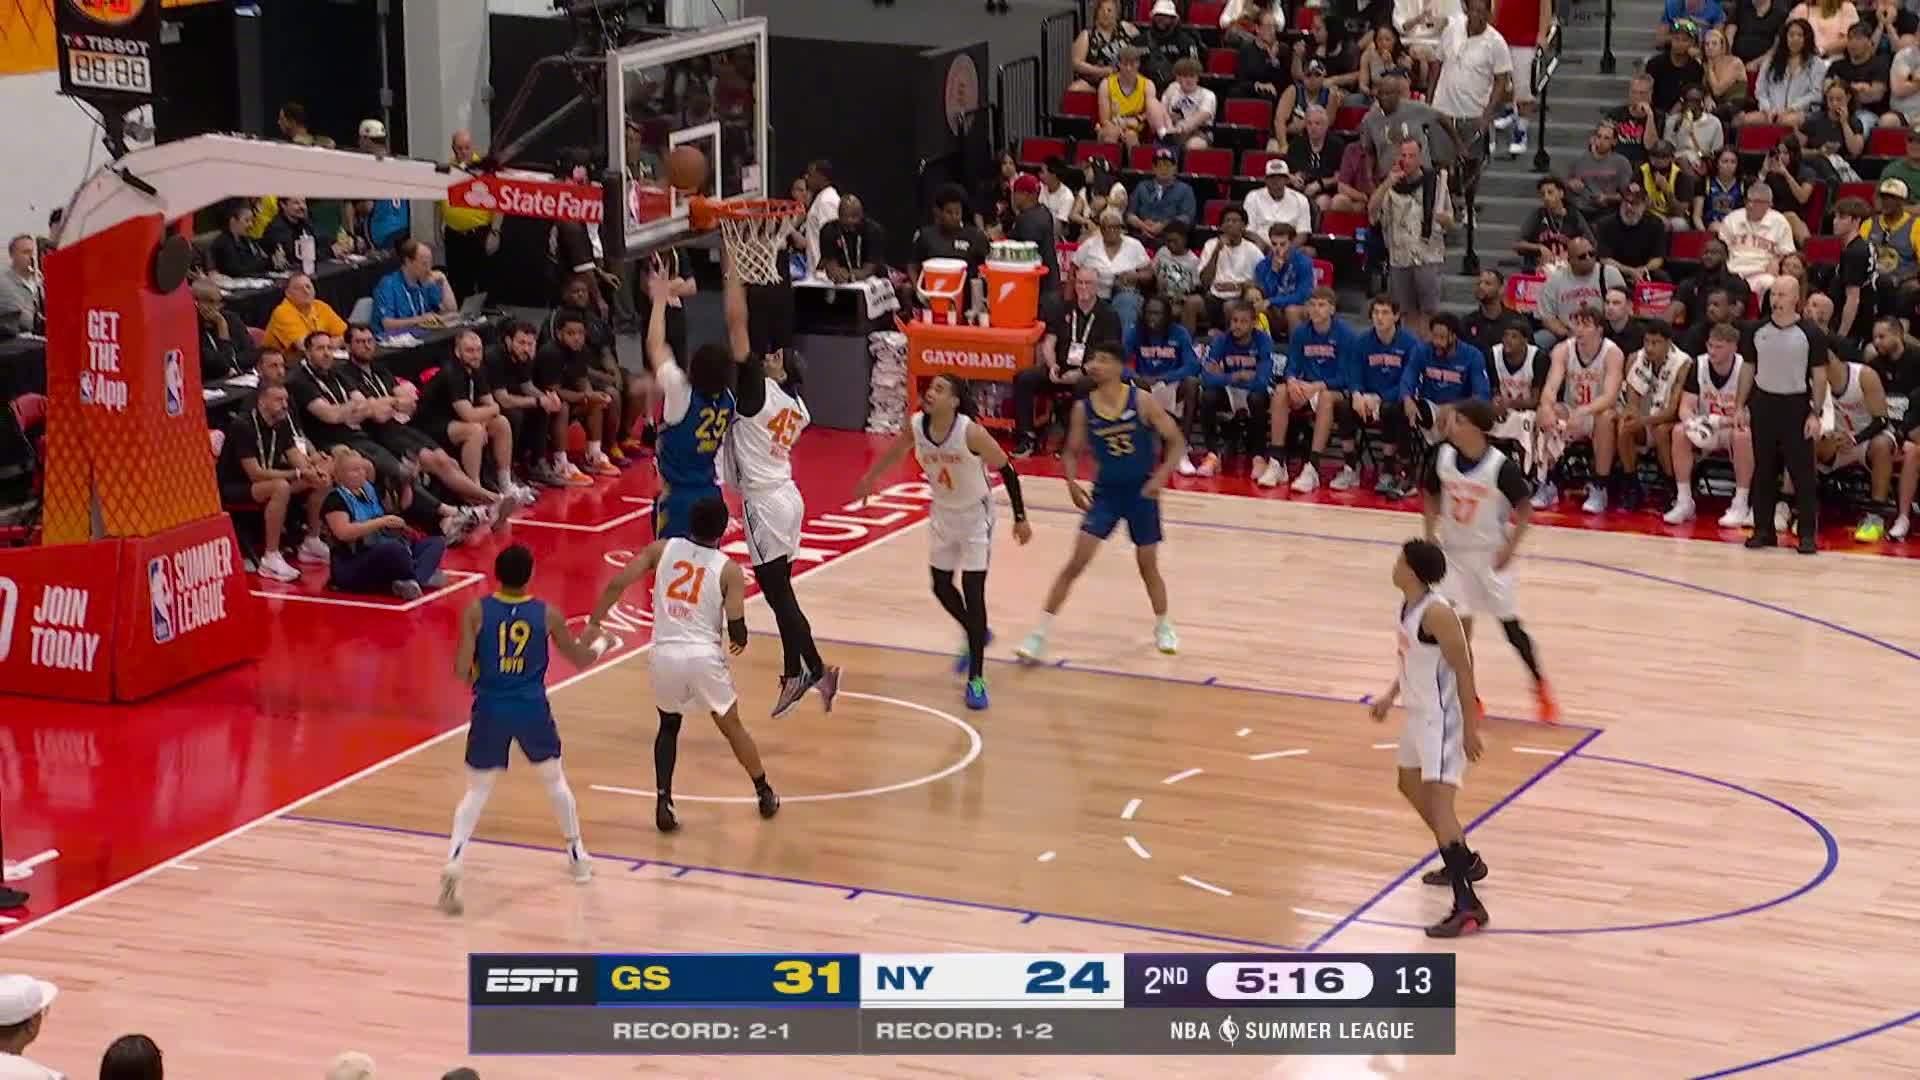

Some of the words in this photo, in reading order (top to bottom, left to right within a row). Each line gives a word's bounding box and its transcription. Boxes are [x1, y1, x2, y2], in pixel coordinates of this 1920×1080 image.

[86, 34, 151, 56] TISSOT
[499, 185, 556, 216] State
[88, 309, 120, 341] GET
[87, 341, 120, 373] THE
[921, 349, 1017, 369] GATORADE
[695, 408, 729, 440] 25
[767, 408, 802, 446] 45
[937, 467, 954, 490] 4
[174, 536, 233, 590] SUMMER
[666, 559, 705, 606] 21
[33, 584, 89, 629] JOIN
[177, 579, 226, 635] LEAGUE
[30, 626, 101, 673] TODAY
[499, 620, 532, 656] 19
